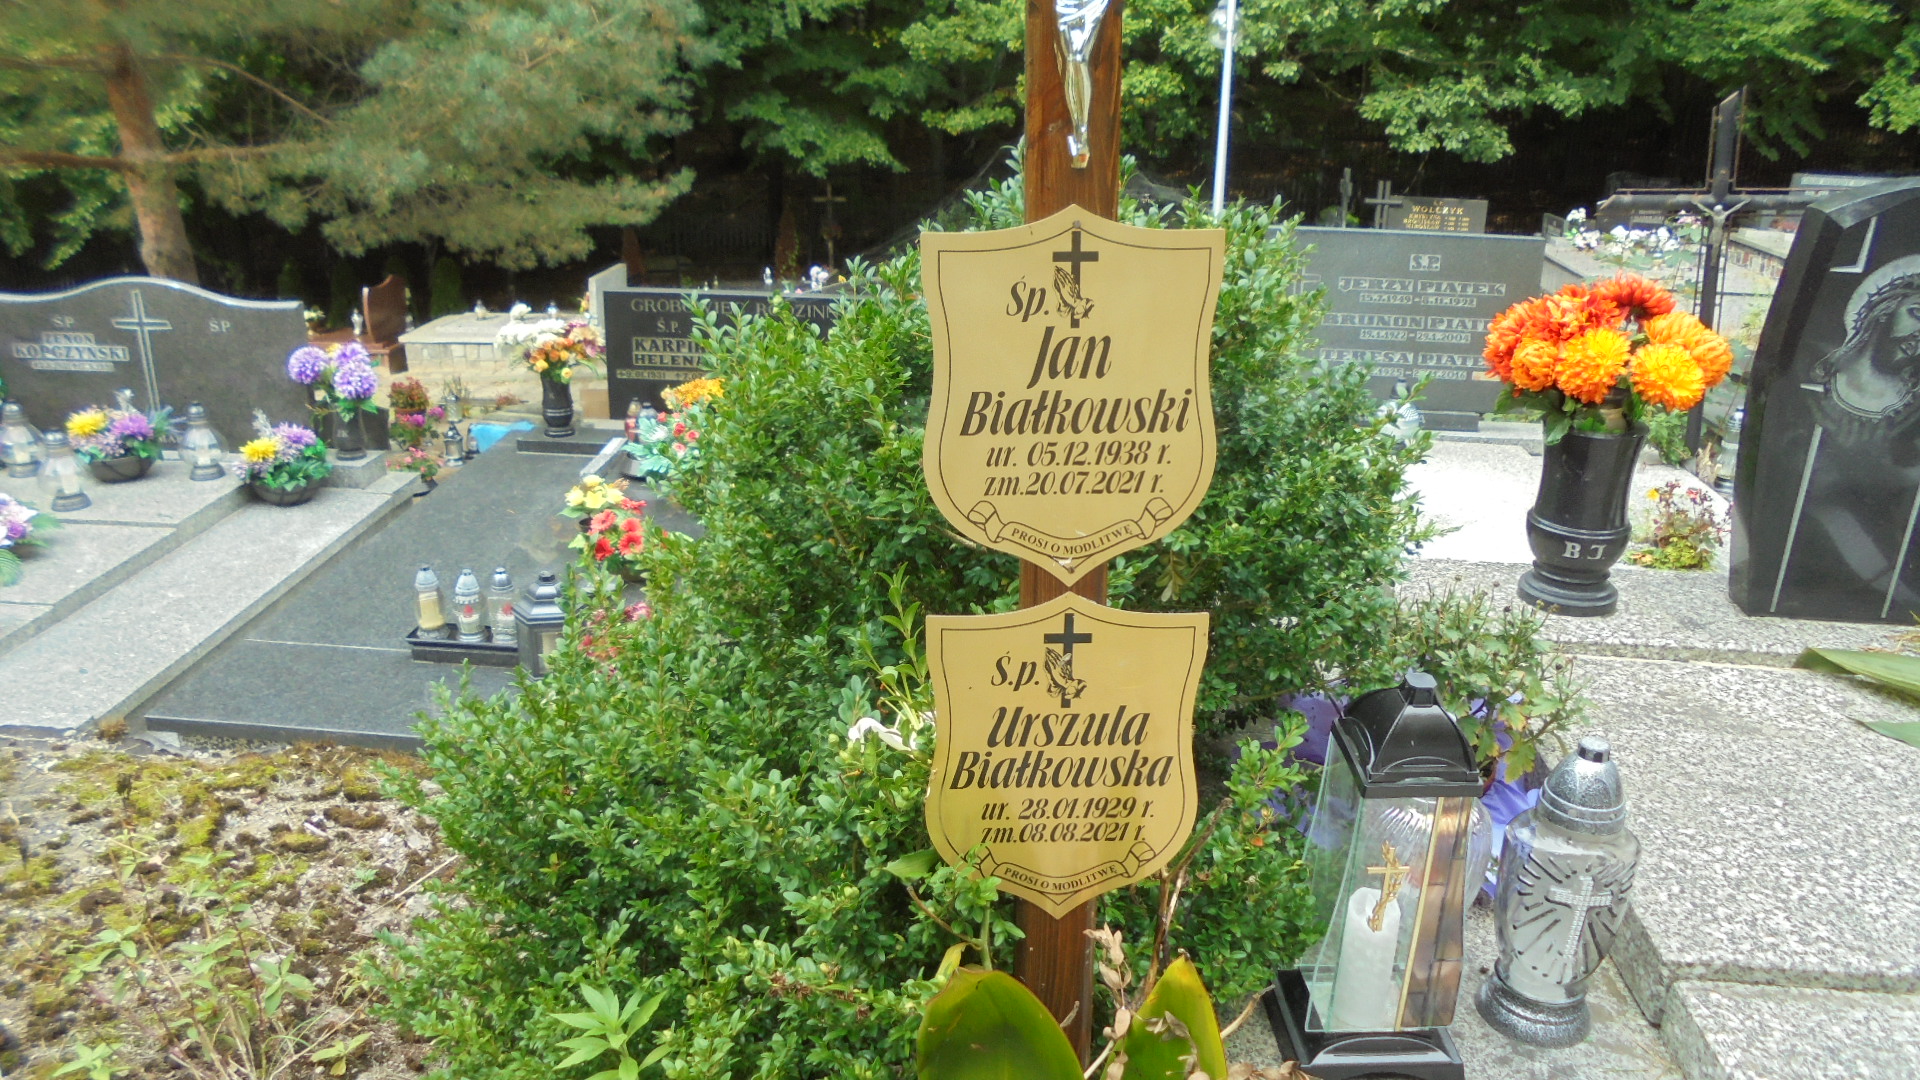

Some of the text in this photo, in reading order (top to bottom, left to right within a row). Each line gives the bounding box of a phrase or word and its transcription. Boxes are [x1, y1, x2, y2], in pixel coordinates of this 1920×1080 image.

[1338, 276, 1414, 291] JERZY
[1006, 275, 1050, 323] Śp.
[1322, 313, 1425, 329] BRUNON
[1026, 325, 1112, 390] Jan
[1320, 348, 1414, 364] TERESA
[959, 388, 1193, 436] Białkowski
[986, 440, 1172, 468] ur. 05.12.1938 r.
[1150, 472, 1164, 494] r.
[1011, 524, 1133, 555] PROSI O MODLITWĘ
[991, 651, 1039, 691] Ś.p.
[987, 705, 1150, 748] Urszula
[949, 749, 1174, 790] Białkowska
[981, 796, 1154, 821] ur. 28.01.1929 r.
[1133, 825, 1146, 841] r.
[1004, 864, 1117, 891] PROSI O MODLITWĘ
